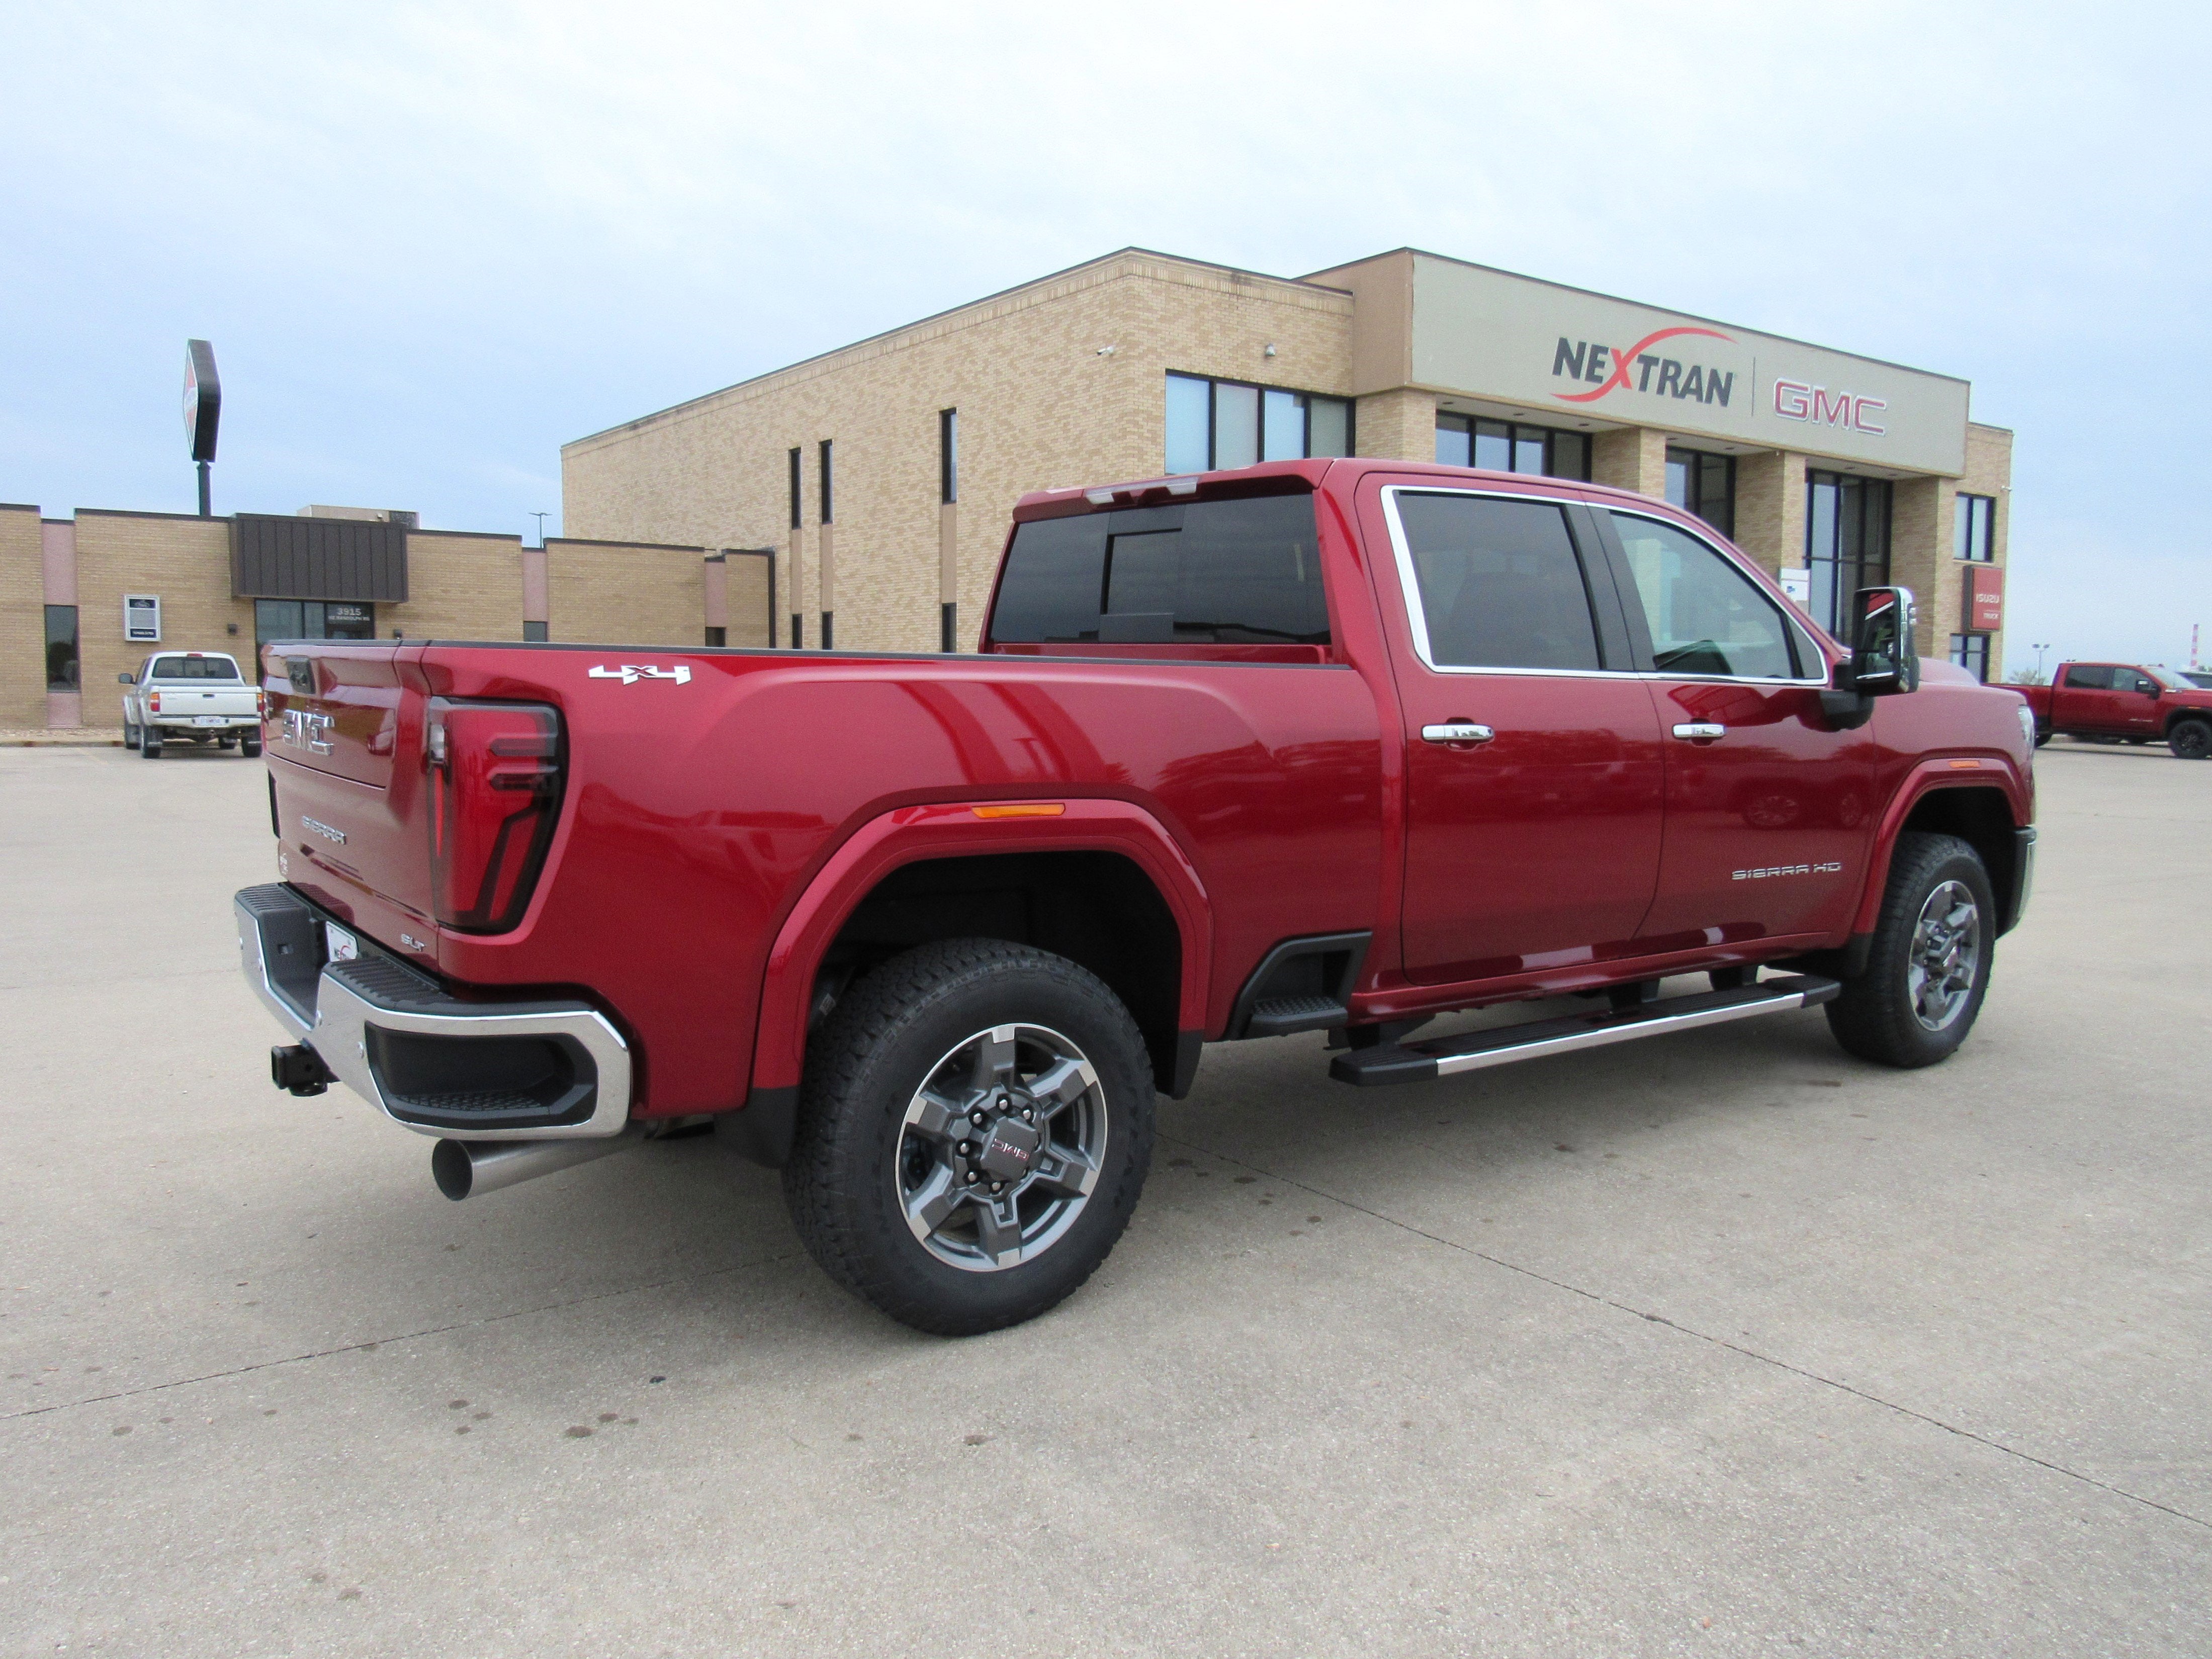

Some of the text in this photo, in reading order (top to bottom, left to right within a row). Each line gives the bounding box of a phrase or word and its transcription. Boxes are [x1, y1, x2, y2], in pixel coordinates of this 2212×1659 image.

[1551, 336, 1735, 408] NEXTRAN
[1774, 378, 1886, 437] GMC
[1976, 594, 2000, 603] ISUZU
[337, 607, 362, 616] 3915
[283, 709, 335, 755] GMC
[302, 815, 346, 845] SIERRA
[1732, 862, 1841, 880] SIERRA HD
[401, 933, 426, 952] SLT
[992, 1138, 1030, 1161] GMC
